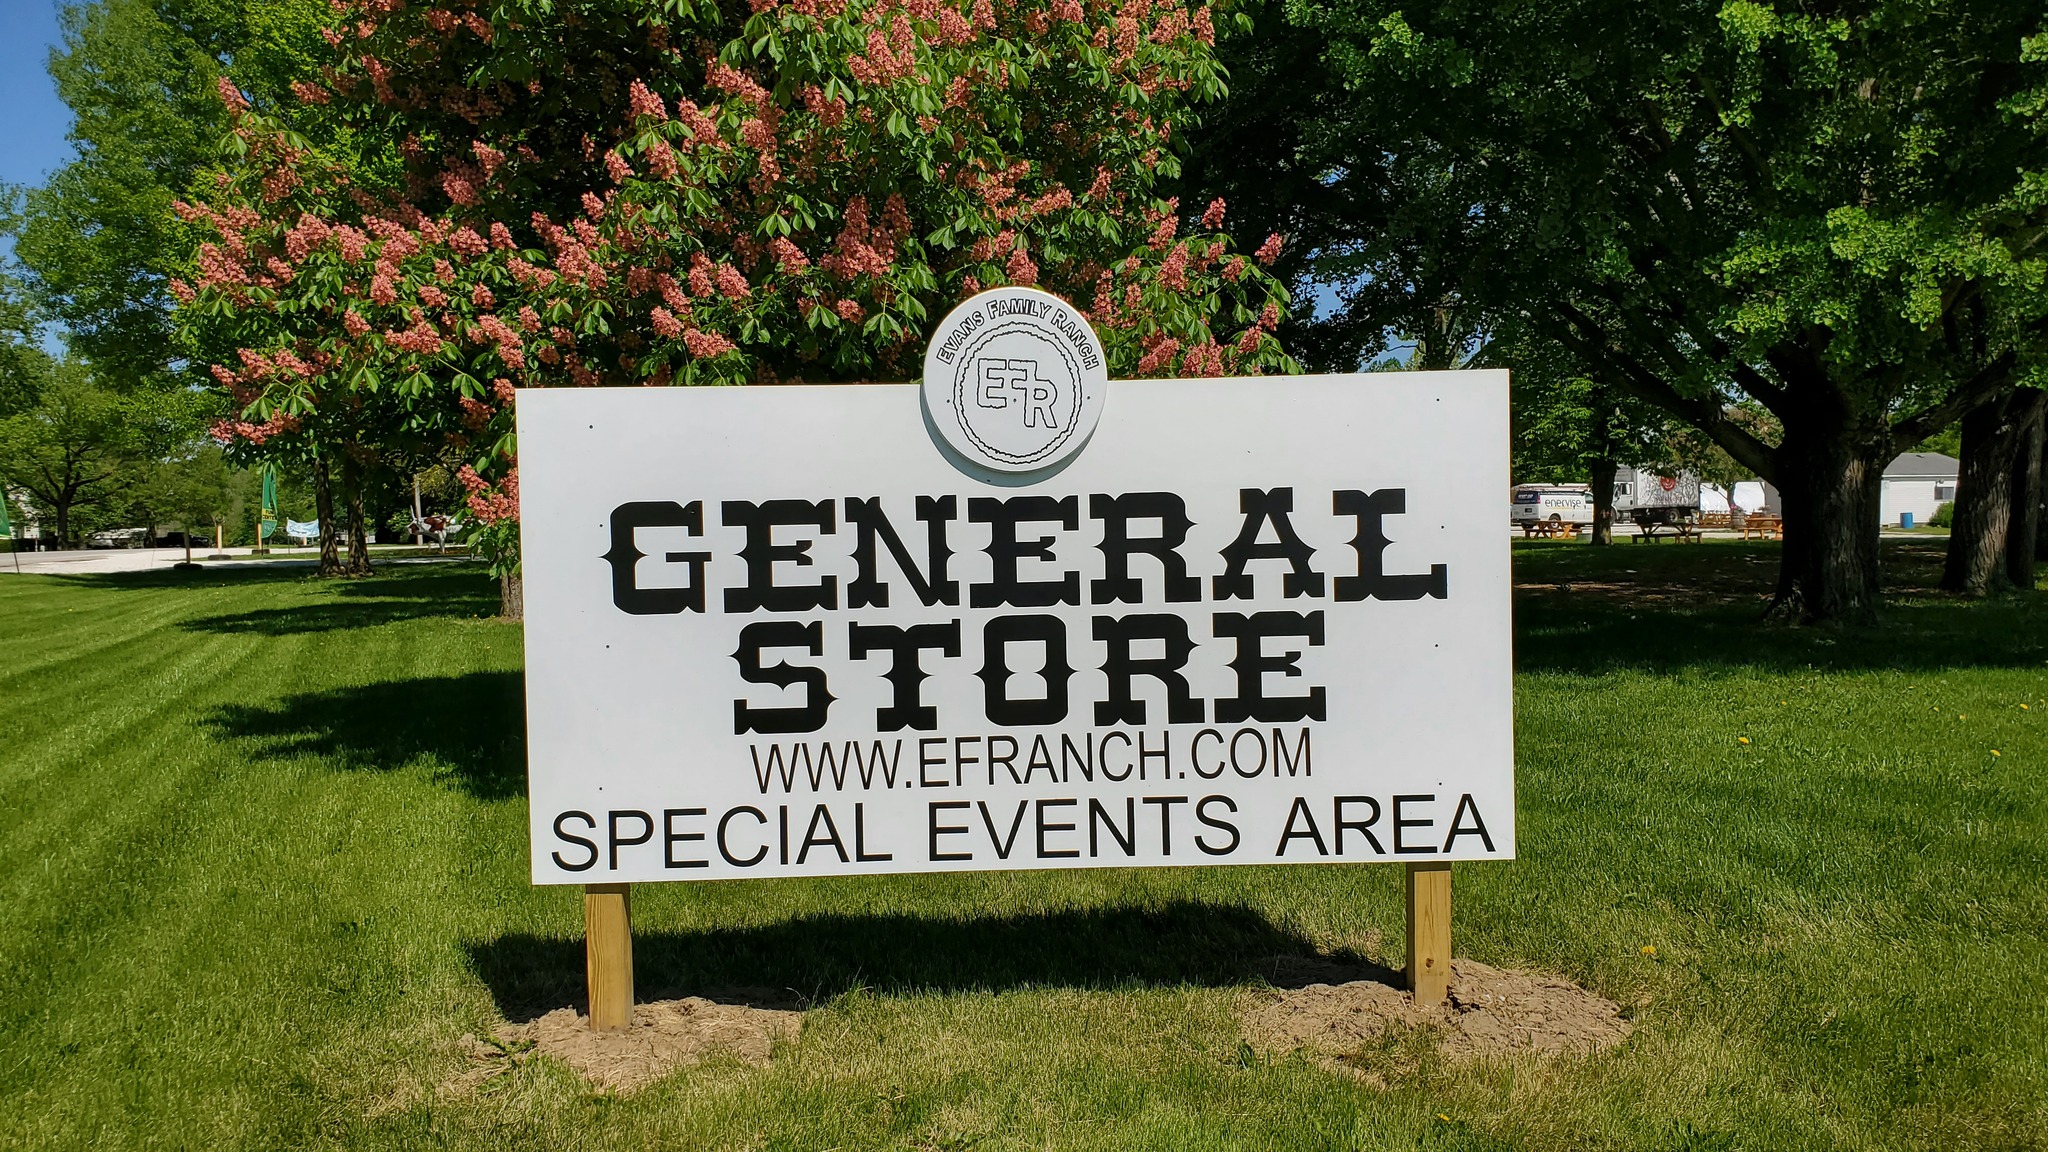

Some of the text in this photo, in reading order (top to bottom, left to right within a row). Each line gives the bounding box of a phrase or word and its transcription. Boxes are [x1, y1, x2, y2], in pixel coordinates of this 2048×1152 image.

[936, 298, 1100, 370] EVANS FAMILY RANCH
[600, 487, 1447, 615] GENERAL
[730, 609, 1326, 735] STORE
[750, 727, 1311, 794] WWW.EFRANCH.COM
[552, 794, 1495, 871] SPECIAL EVENTS AREA
